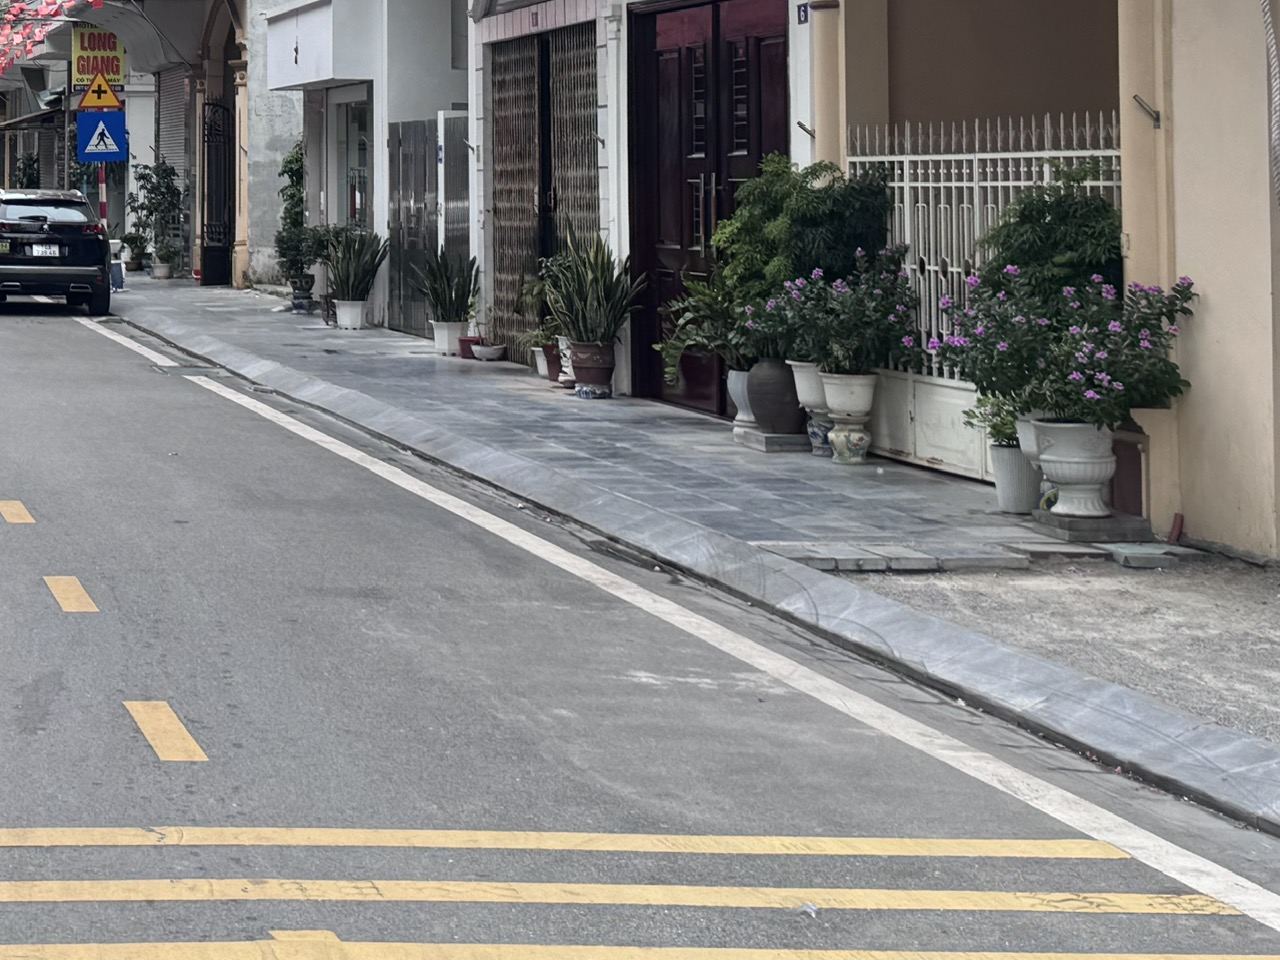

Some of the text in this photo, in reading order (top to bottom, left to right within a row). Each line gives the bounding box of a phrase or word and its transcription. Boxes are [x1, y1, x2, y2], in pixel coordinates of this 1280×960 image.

[800, 6, 805, 22] 6
[80, 32, 117, 51] LONG
[76, 55, 120, 75] GIANG
